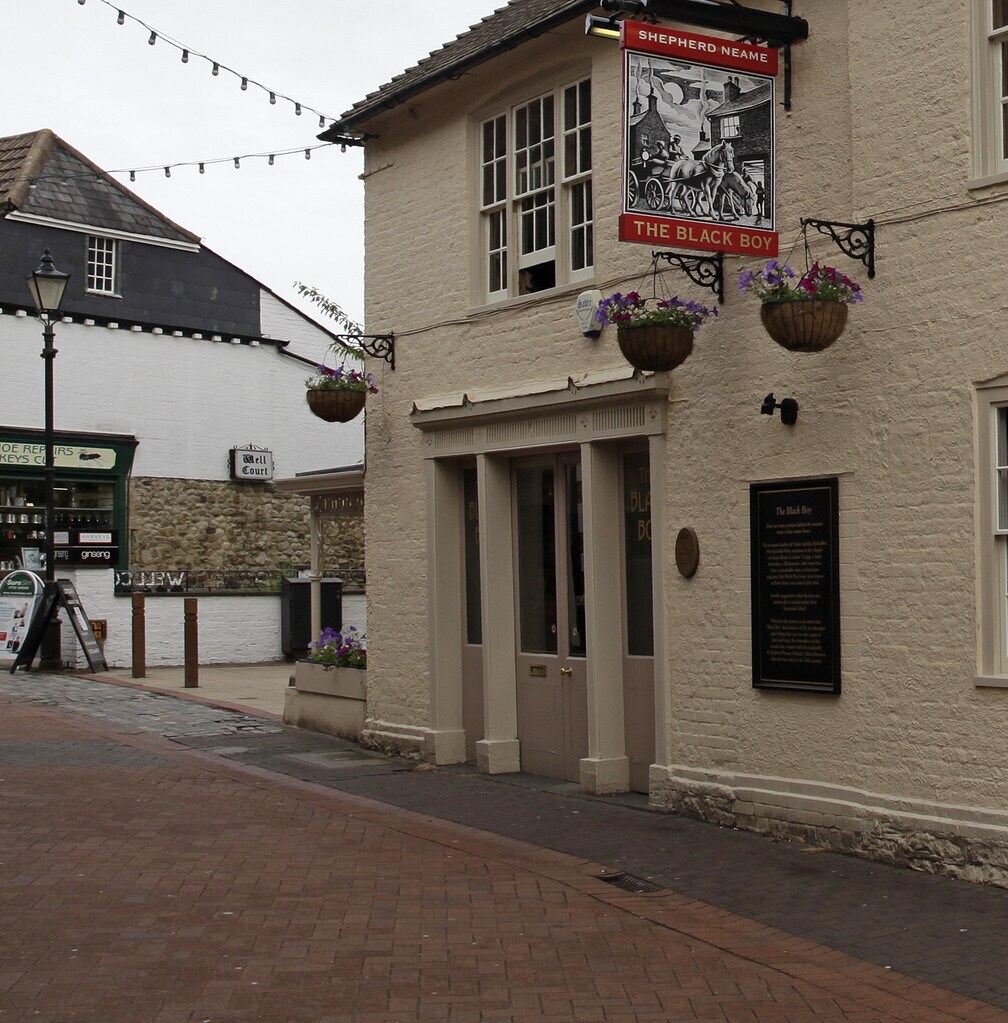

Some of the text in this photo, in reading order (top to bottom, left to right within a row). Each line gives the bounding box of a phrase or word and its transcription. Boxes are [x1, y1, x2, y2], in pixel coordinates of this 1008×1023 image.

[638, 30, 768, 63] SHEPHERD NEAME
[633, 220, 773, 251] THE BLACK BOY
[0, 443, 74, 456] OE REPIRS
[242, 454, 267, 465] Well
[241, 465, 268, 476] Court
